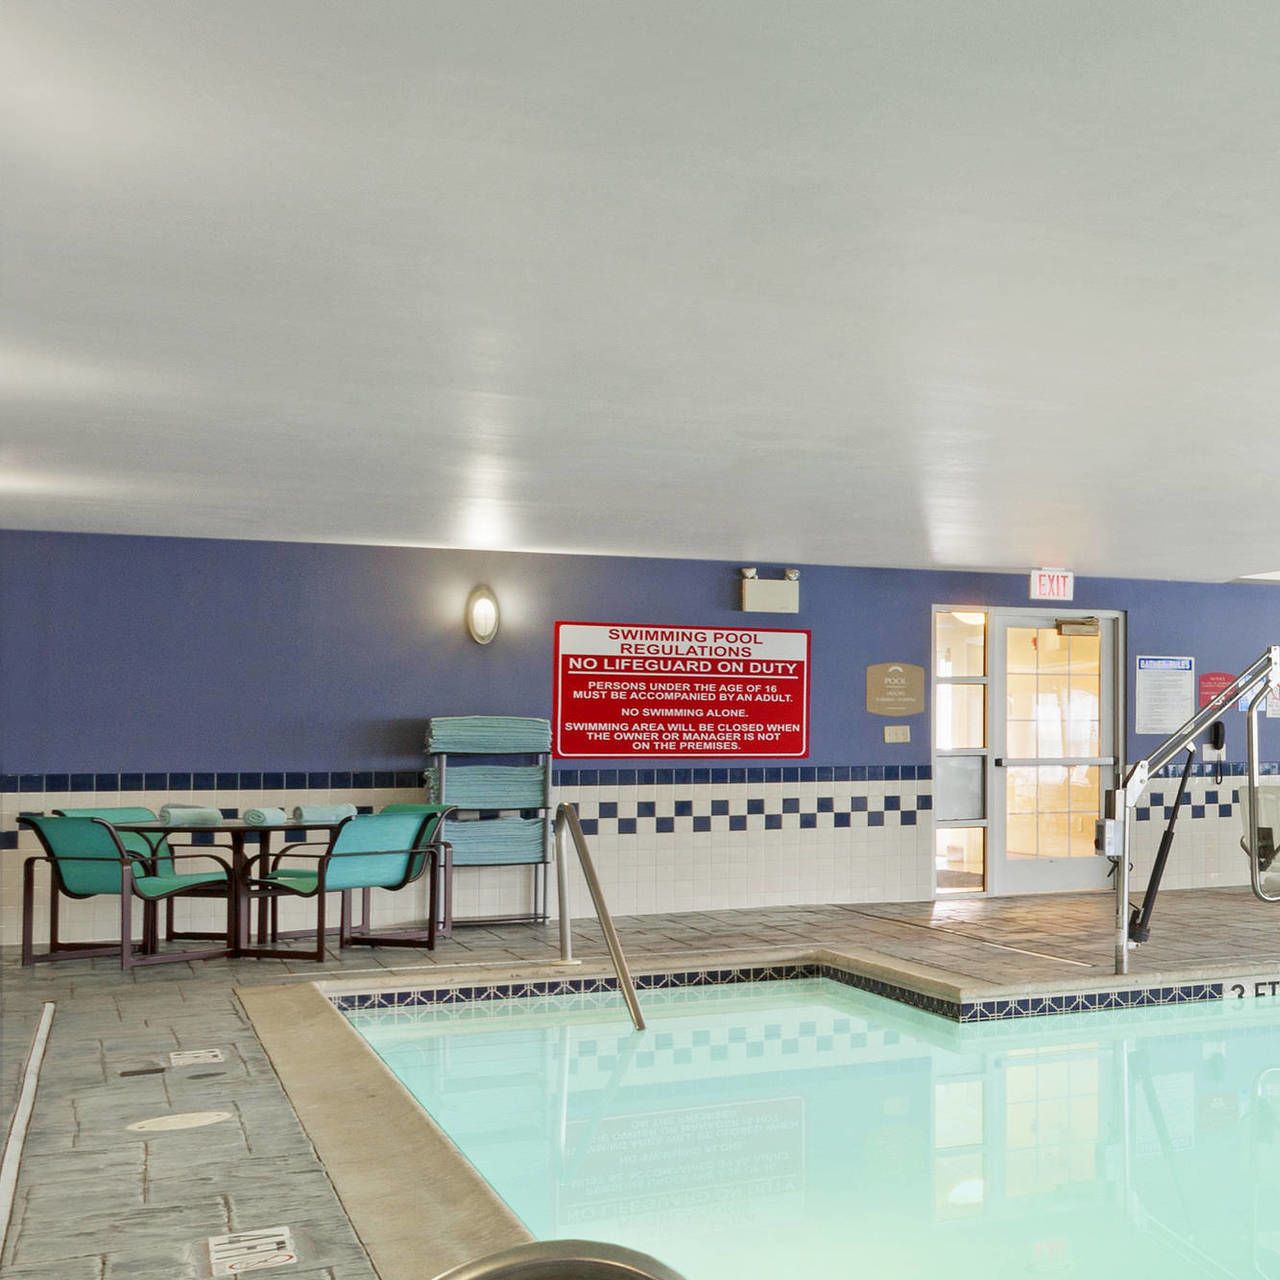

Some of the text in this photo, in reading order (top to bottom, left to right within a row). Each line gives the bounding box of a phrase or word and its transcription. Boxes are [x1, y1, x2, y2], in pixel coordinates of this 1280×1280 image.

[1038, 573, 1069, 597] EXIT
[608, 628, 763, 645] SWIMMING POOL
[620, 643, 752, 657] REGULATIONS
[569, 657, 797, 674] NO LIFEGUARD ON DUTY
[588, 681, 777, 693] PERSONS UNDER THE AGE OF 16
[573, 690, 793, 702] MUST BE ACCOMPANIED BY AN ADULT.
[621, 708, 749, 717] NO SWIMMING ALONE.
[565, 722, 800, 732] SWIMMING AREA WILL BE CLOSED WHEN
[587, 732, 781, 741] THE OWNER OR MANAGER IS NOT
[632, 741, 741, 750] ON THE PREMISES.
